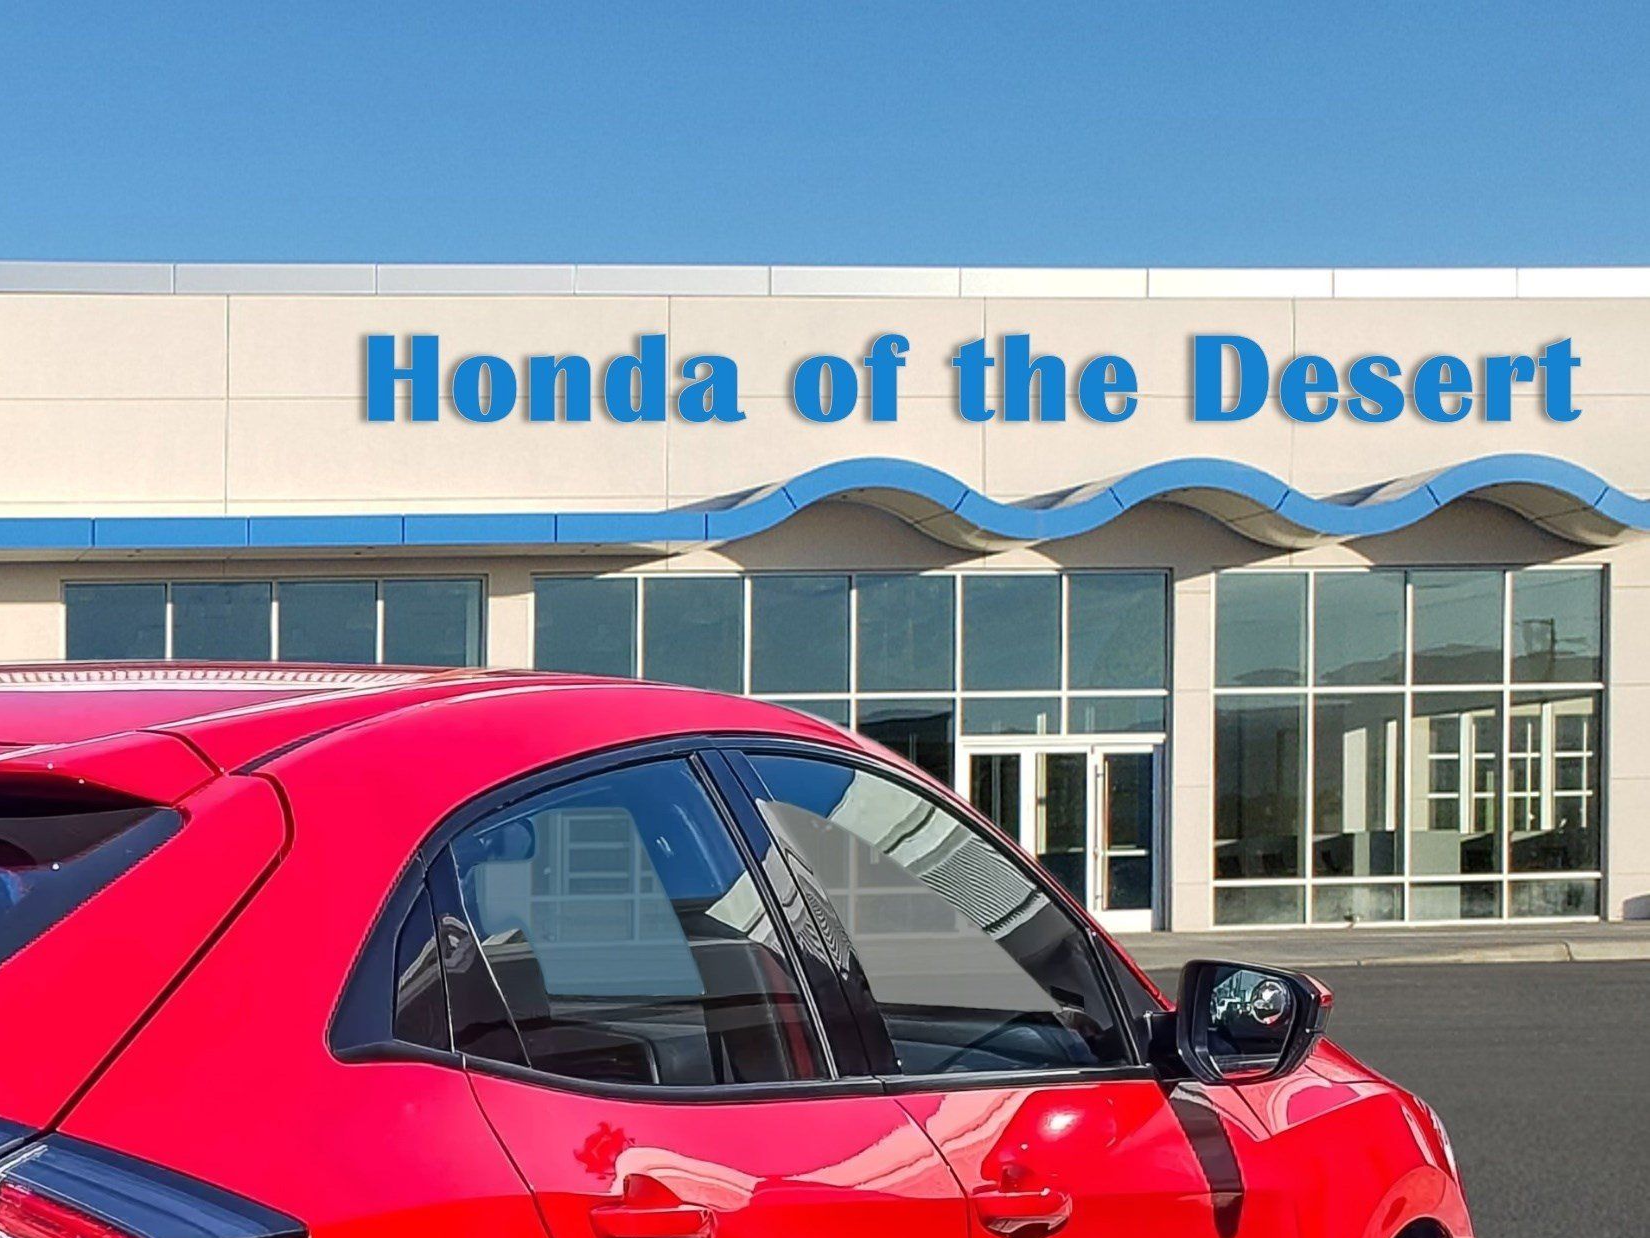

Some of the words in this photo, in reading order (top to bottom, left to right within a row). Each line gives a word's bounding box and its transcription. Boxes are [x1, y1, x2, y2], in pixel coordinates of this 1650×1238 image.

[367, 333, 747, 423] Honda
[793, 334, 910, 423] of
[952, 335, 1138, 423] the
[1194, 335, 1582, 423] Desert
